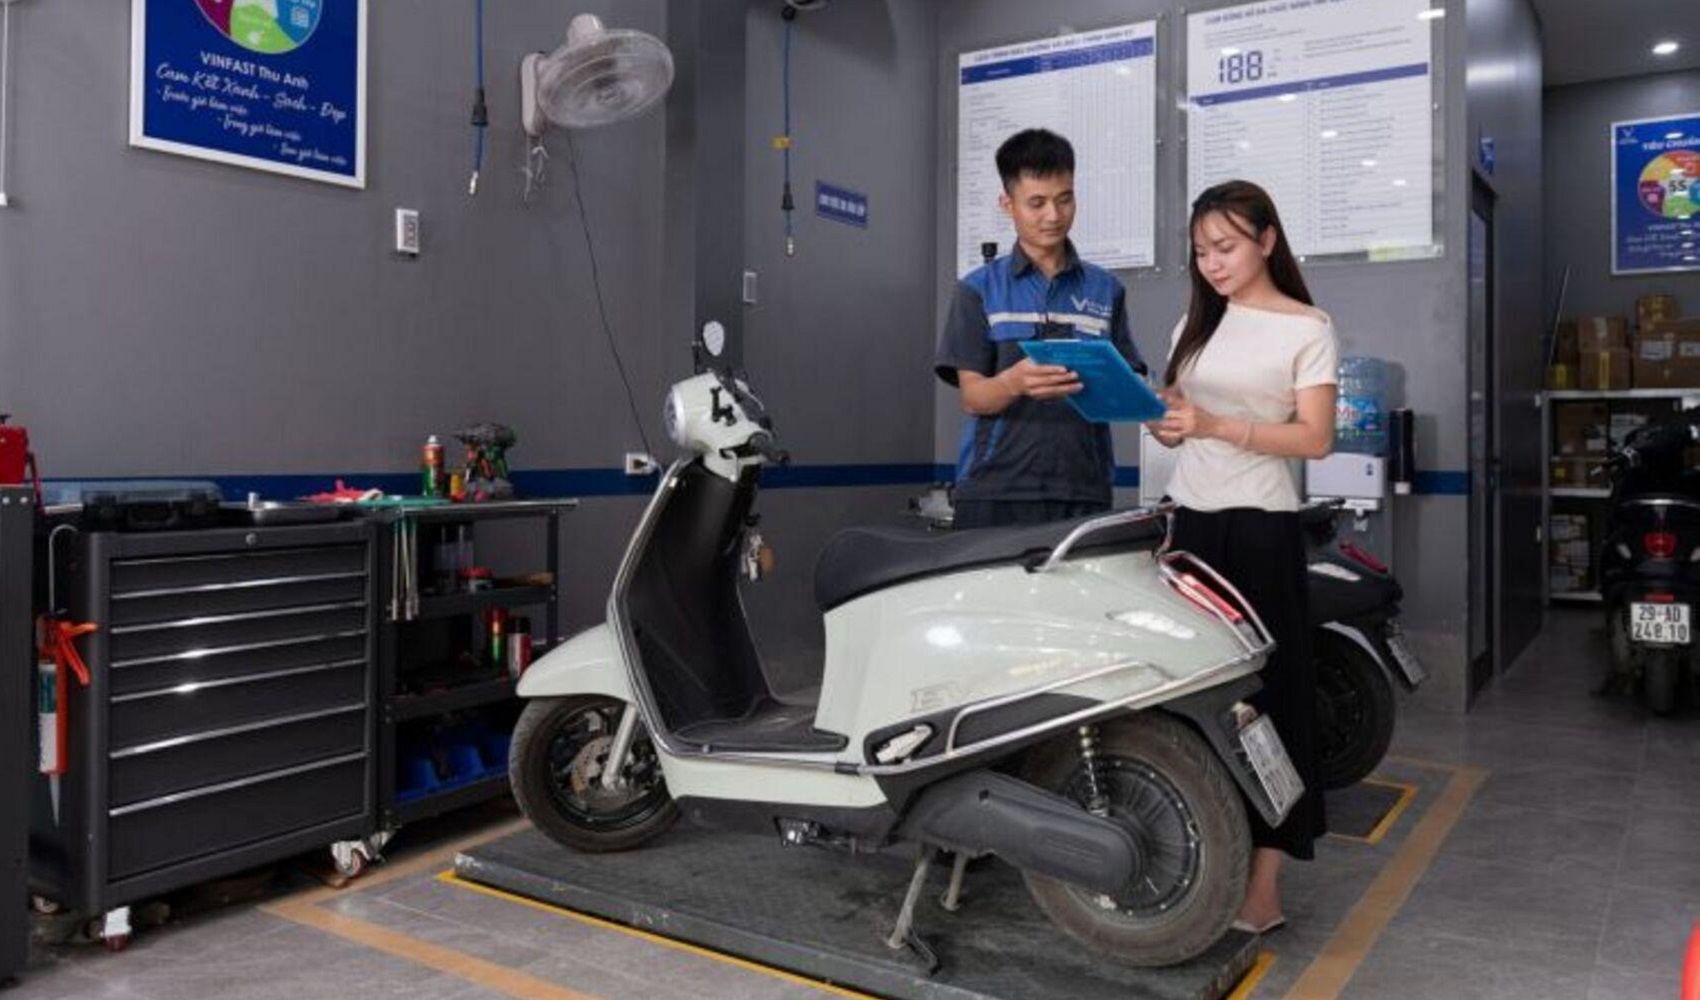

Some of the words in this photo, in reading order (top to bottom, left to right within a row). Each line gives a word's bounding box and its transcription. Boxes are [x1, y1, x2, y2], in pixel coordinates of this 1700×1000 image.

[200, 50, 255, 76] VINFAST
[259, 65, 280, 81] Thu
[284, 72, 310, 89] Anh
[1669, 179, 1687, 192] 5S
